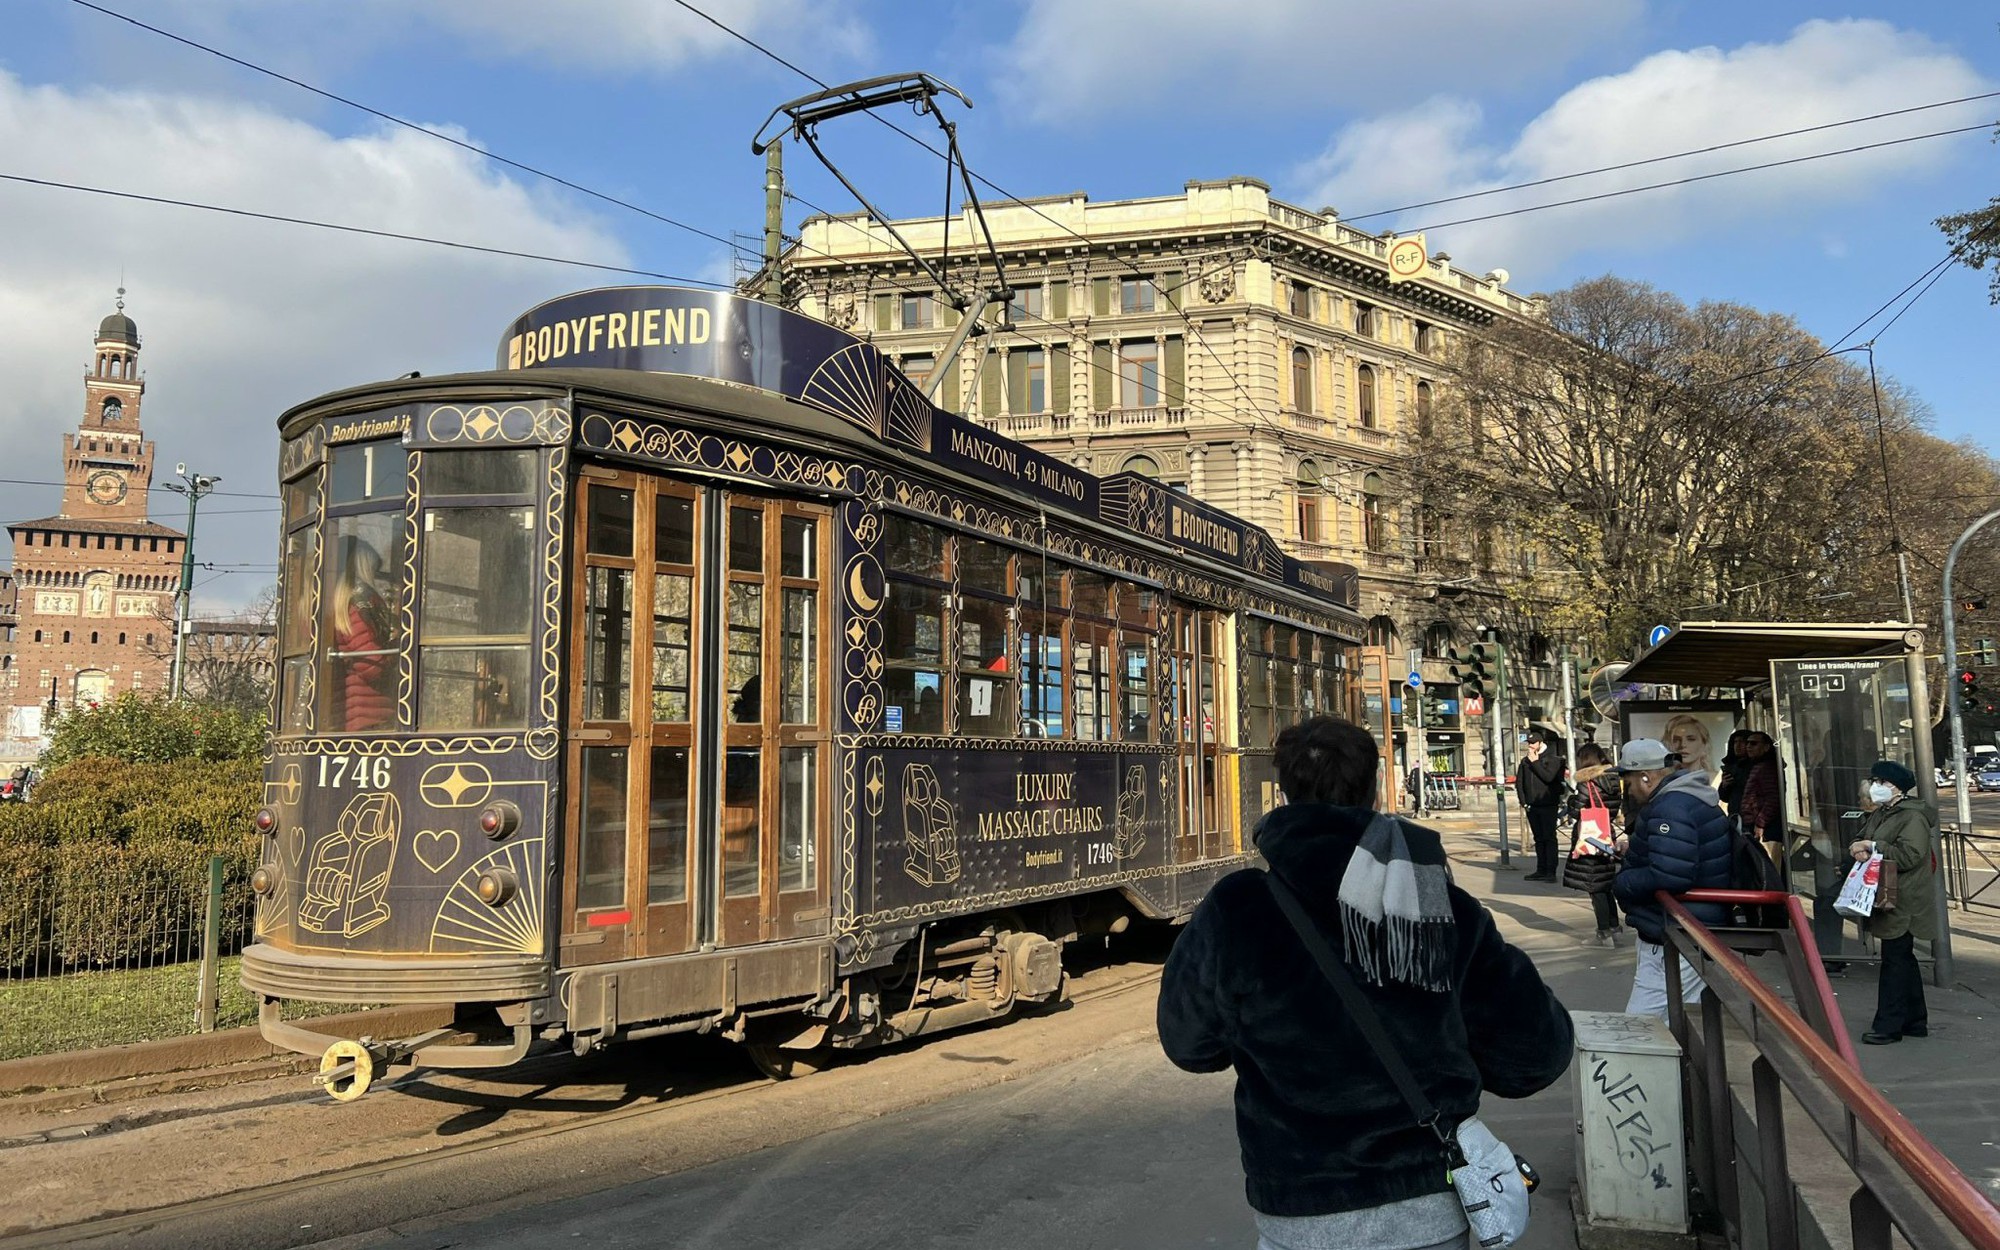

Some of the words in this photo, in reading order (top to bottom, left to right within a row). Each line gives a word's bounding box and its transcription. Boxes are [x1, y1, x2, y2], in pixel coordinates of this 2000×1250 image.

[1395, 252, 1418, 265] R-F
[524, 307, 710, 368] BODYFRIEND
[331, 415, 412, 442] Bodyfriend.it
[364, 446, 373, 496] 1
[951, 428, 1020, 480] MANZONI,
[1024, 460, 1037, 482] 43
[1041, 465, 1084, 501] MILANO
[1183, 511, 1239, 557] BODYFRIEND
[1818, 662, 1826, 670] in
[1465, 697, 1481, 711] M
[318, 755, 391, 790] 1746
[1016, 773, 1073, 802] LUXURY
[978, 809, 1050, 842] MASSAGE
[1053, 806, 1103, 835] CHAIRS
[1087, 842, 1113, 865] 1746
